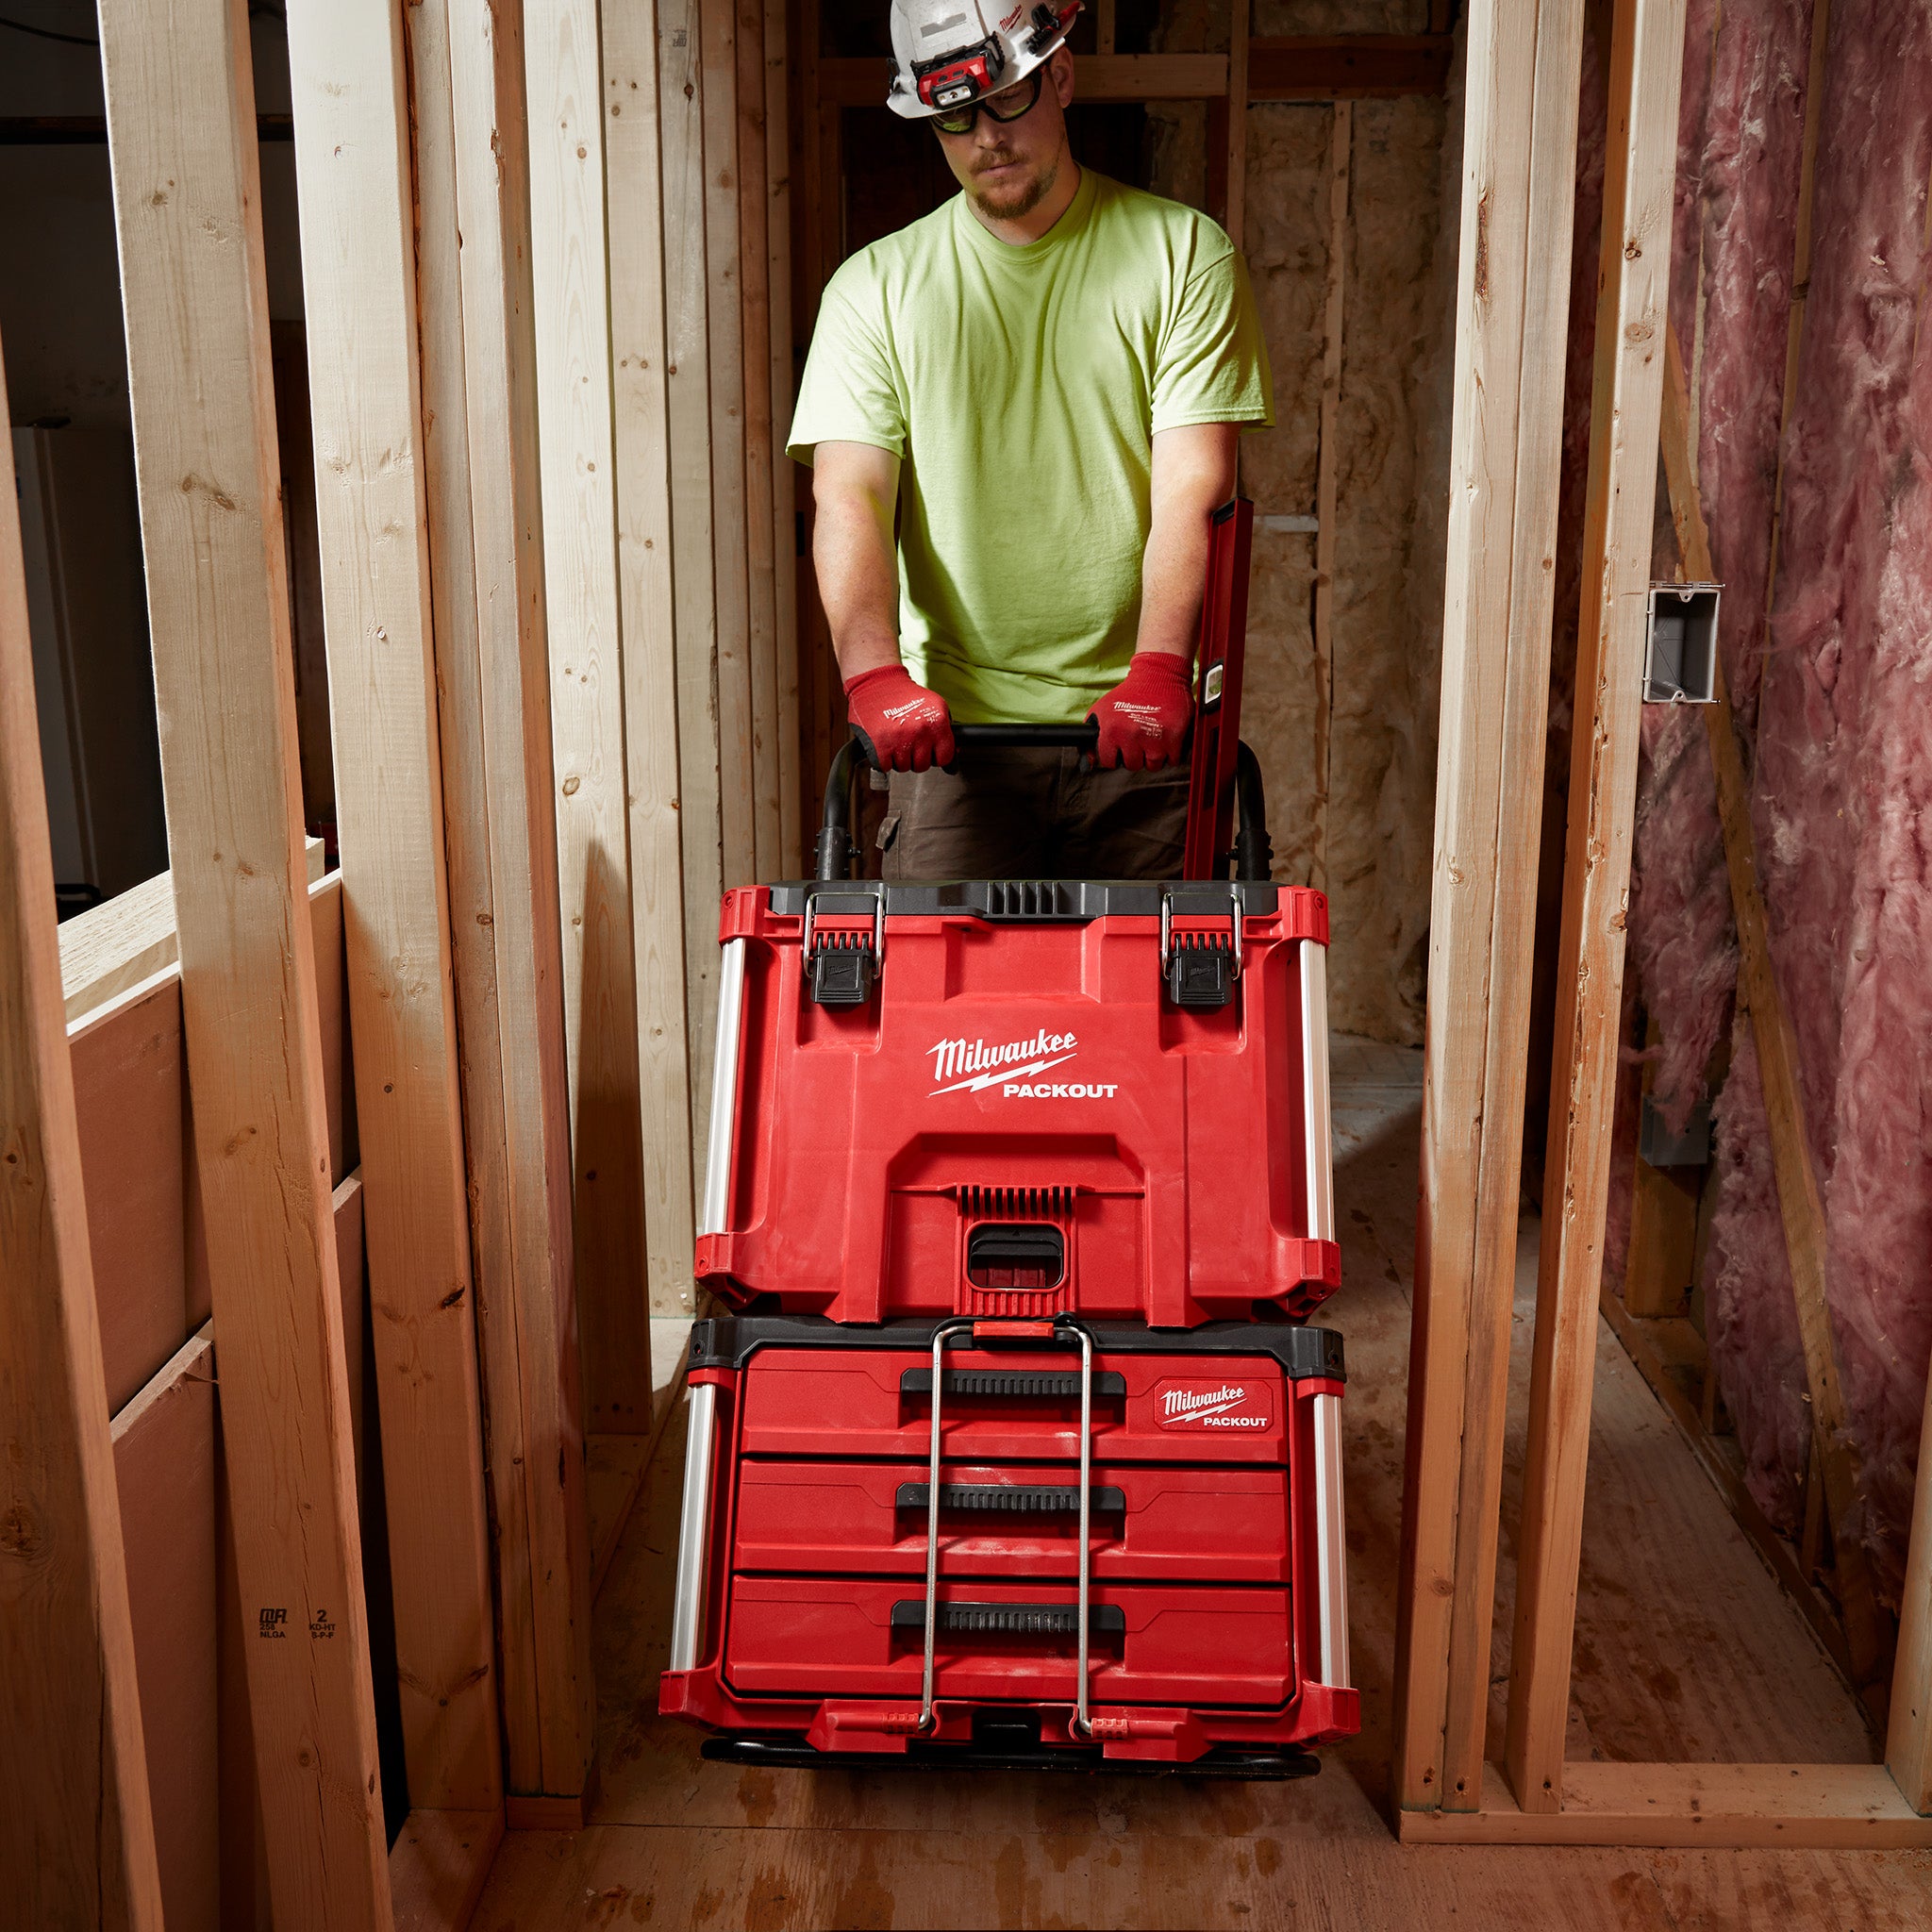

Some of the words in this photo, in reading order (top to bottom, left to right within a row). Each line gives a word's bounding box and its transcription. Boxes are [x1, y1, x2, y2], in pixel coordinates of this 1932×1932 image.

[883, 697, 925, 719] Milwaukee
[1113, 701, 1161, 711] Milwaukee
[924, 1028, 1078, 1082] Milwaukee
[1003, 1084, 1118, 1098] PACKOUT
[1159, 1385, 1245, 1416] Milwaukee
[1203, 1417, 1268, 1427] PACKOUT
[316, 1609, 327, 1623] 2
[308, 1623, 336, 1631] KD-HT
[259, 1630, 287, 1639] NLGA
